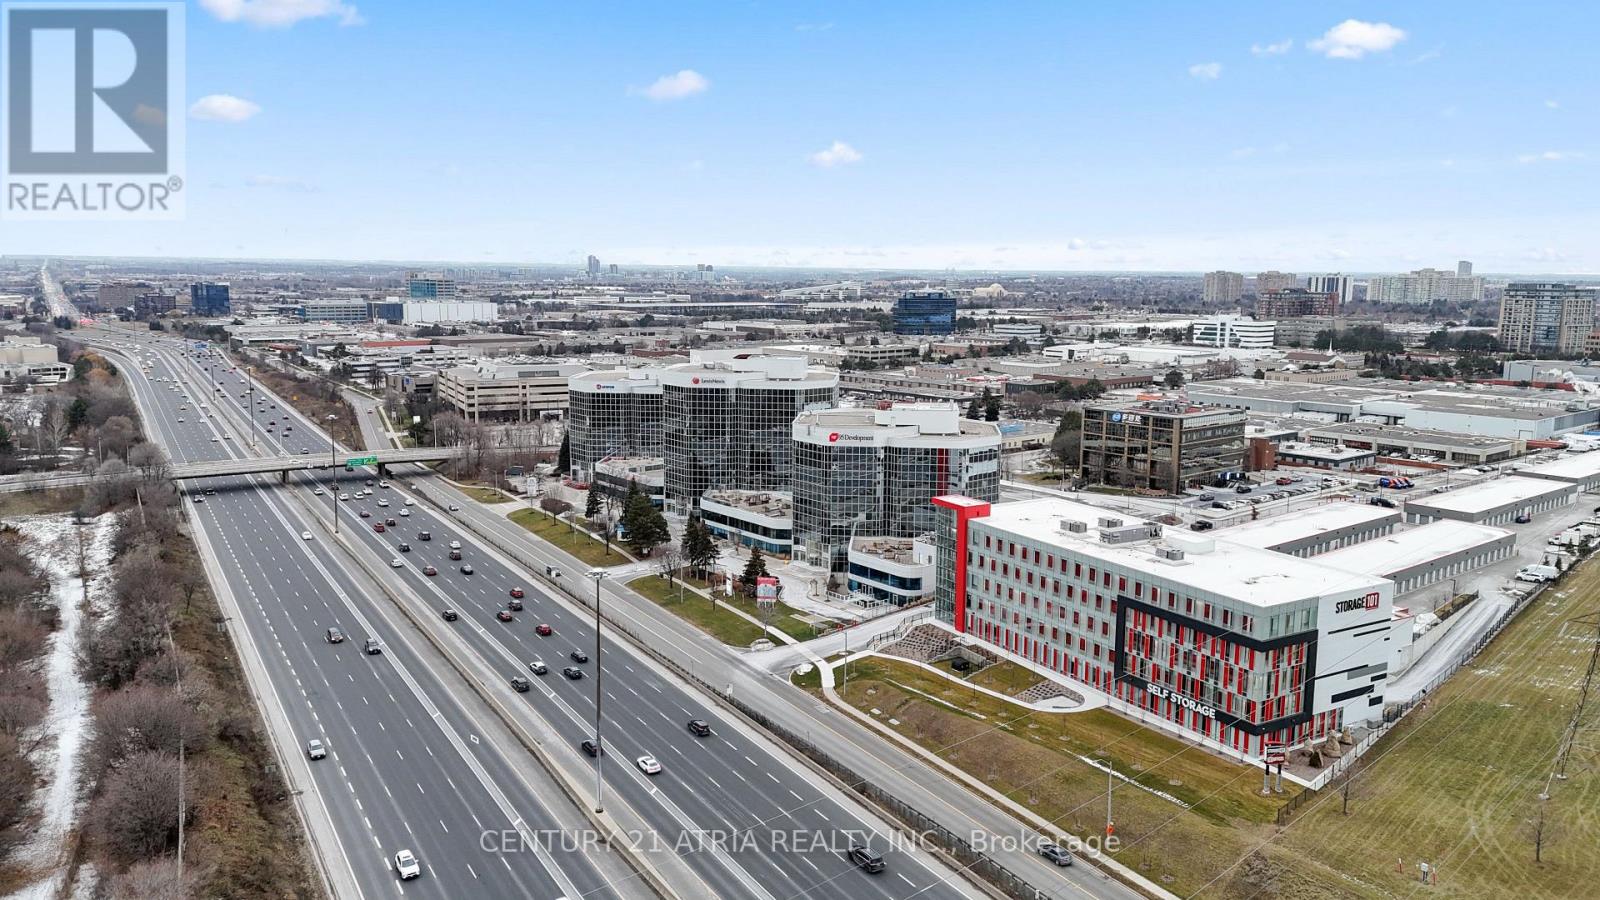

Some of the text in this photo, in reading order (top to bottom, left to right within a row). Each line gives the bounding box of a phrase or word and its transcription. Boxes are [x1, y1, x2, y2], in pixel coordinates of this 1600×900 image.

[1335, 593, 1379, 613] STORAGE 101
[1147, 683, 1216, 719] SELF STORAGE
